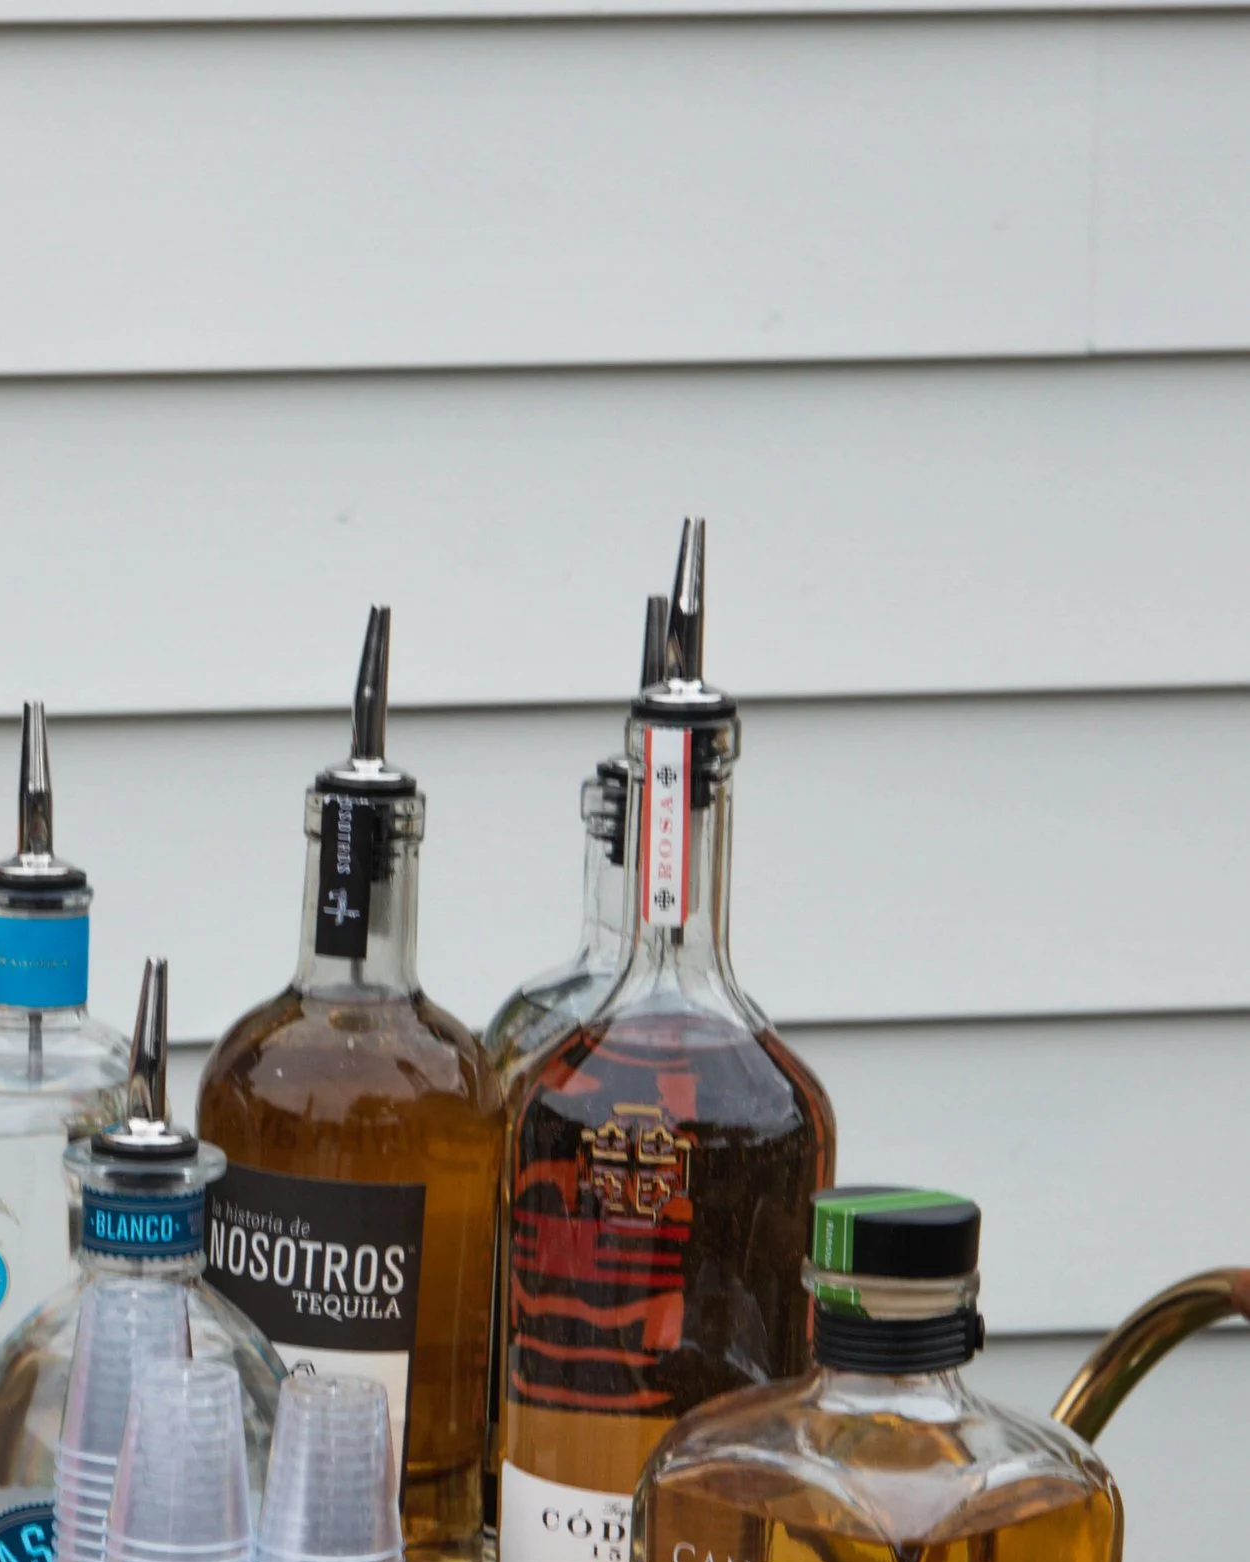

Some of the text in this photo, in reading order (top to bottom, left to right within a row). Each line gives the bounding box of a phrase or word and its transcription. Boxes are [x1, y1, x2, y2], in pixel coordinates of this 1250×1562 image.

[658, 796, 674, 879] ROSA
[96, 1209, 173, 1243] BLANCO
[225, 1199, 283, 1235] historia
[289, 1215, 311, 1239] de
[209, 1217, 406, 1296] NOSOTROS
[292, 1289, 402, 1322] TEQUILA
